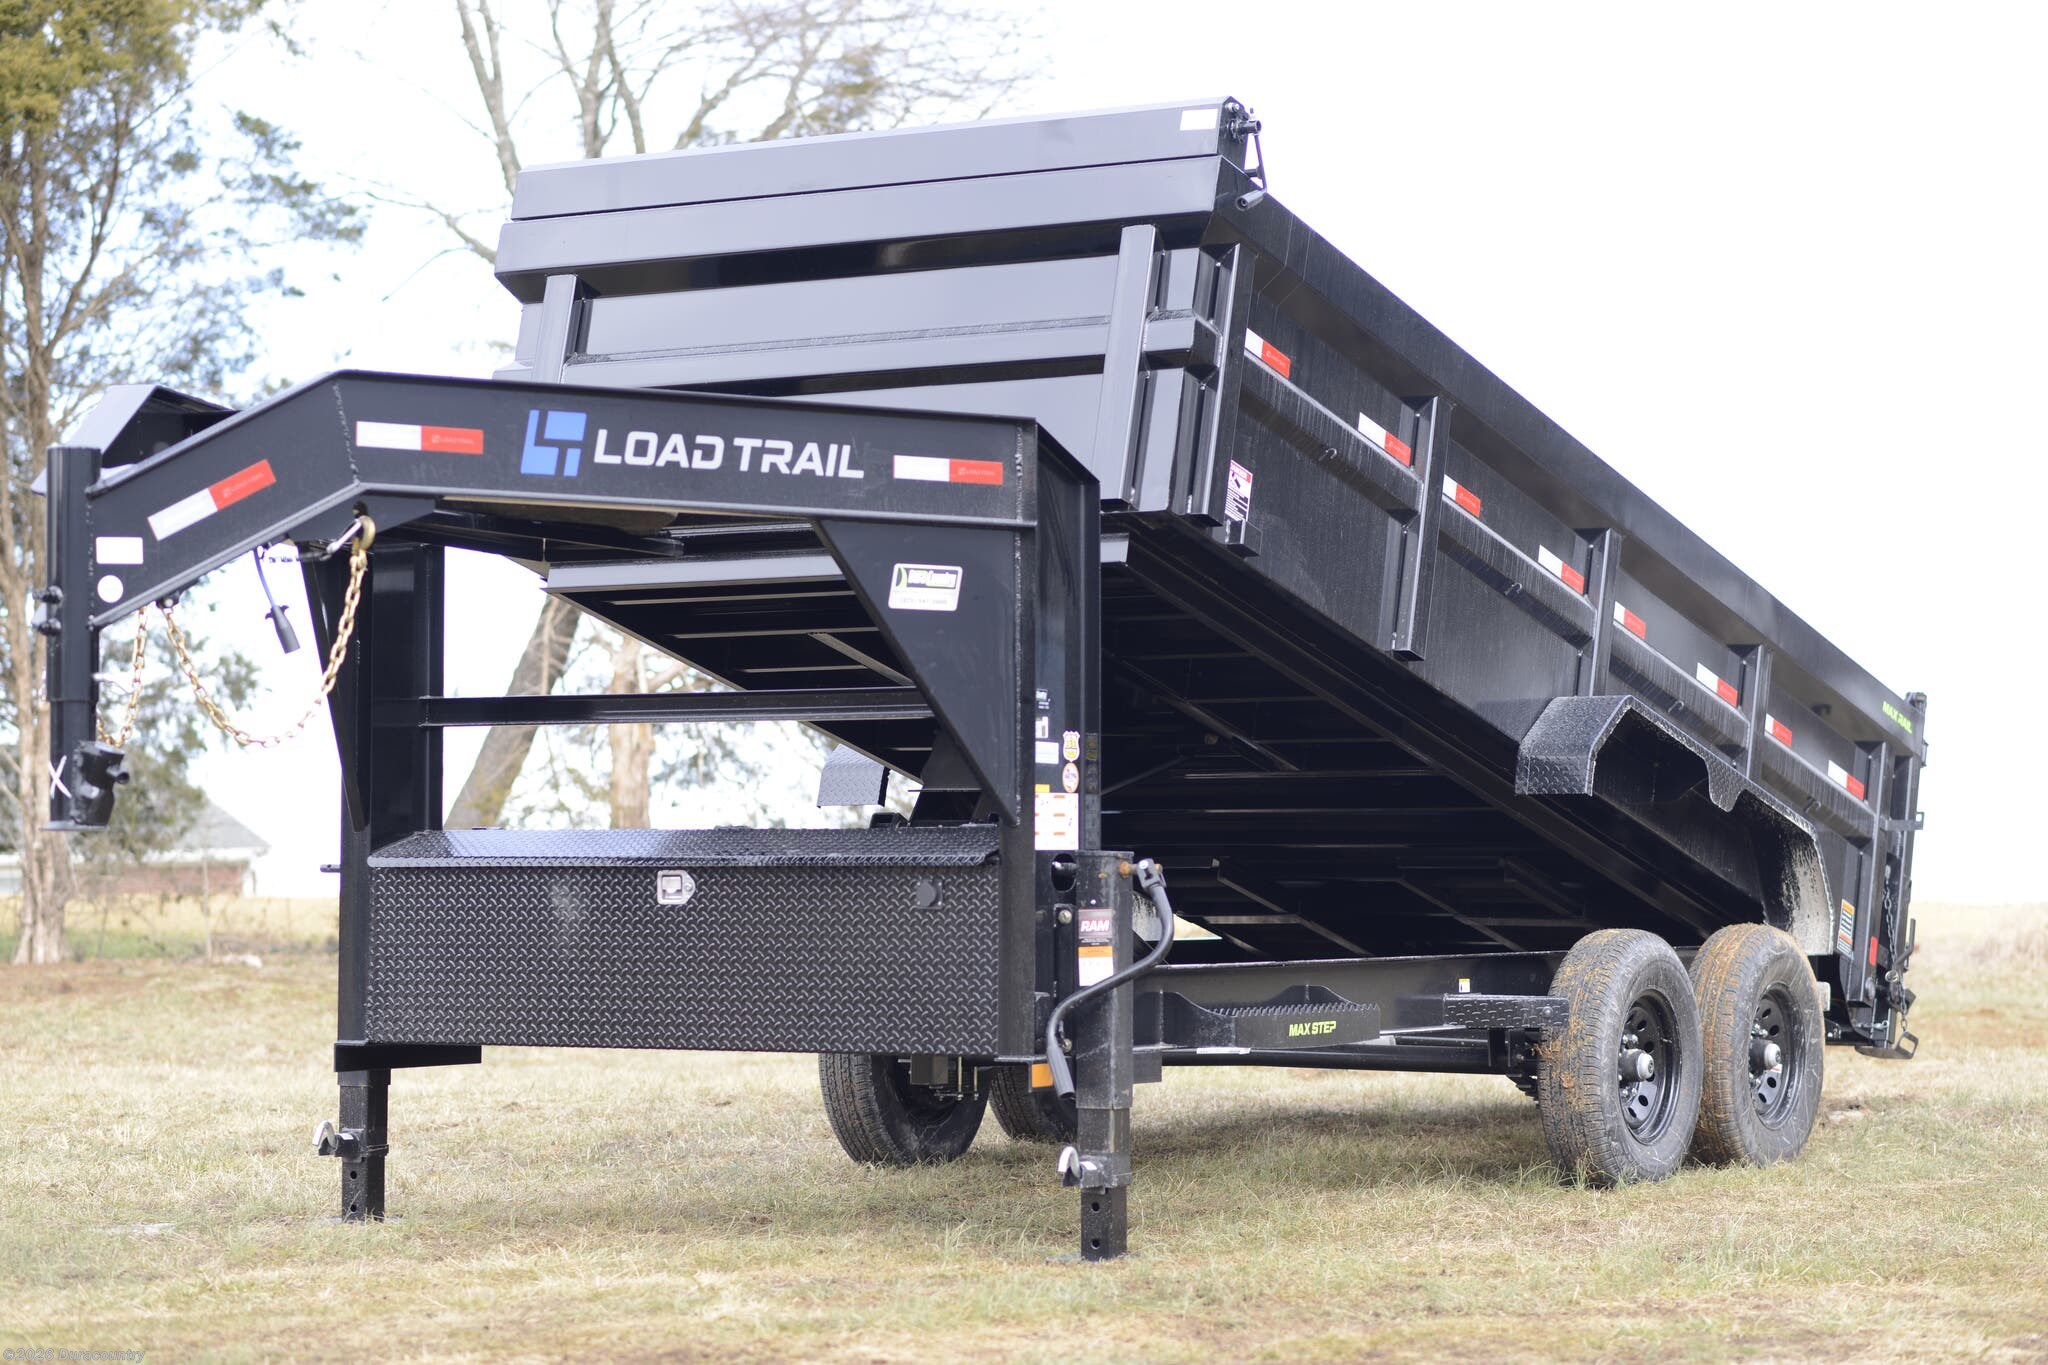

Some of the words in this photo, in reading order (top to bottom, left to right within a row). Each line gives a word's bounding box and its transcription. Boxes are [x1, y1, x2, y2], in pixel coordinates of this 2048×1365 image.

[593, 429, 725, 471] LOAD
[732, 436, 865, 480] TRAIL
[1882, 700, 1898, 723] MAX
[1080, 919, 1110, 932] RAM
[1288, 1022, 1311, 1037] MAX
[1311, 1020, 1337, 1035] STEP
